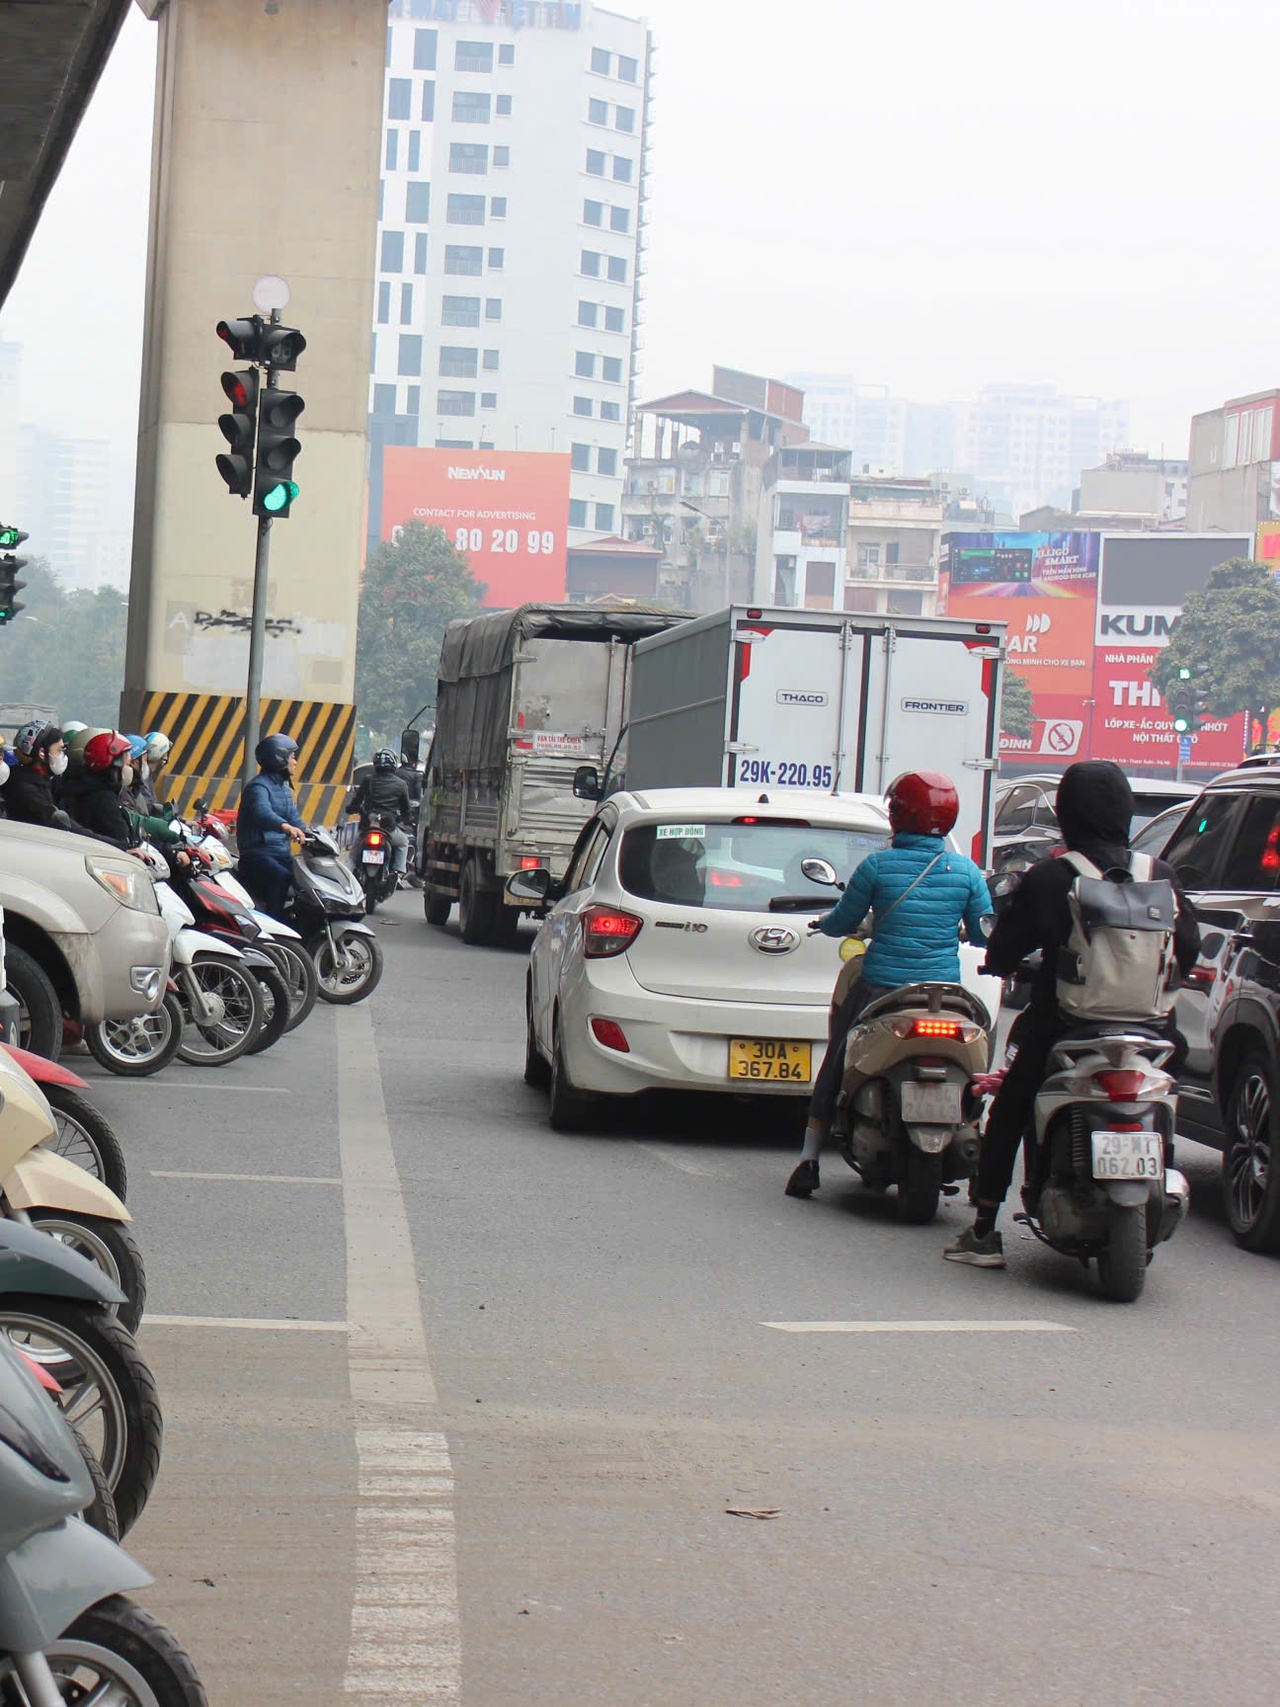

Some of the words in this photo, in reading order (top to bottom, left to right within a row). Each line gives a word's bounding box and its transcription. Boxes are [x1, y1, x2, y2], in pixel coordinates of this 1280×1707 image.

[413, 507, 455, 518] CONTACT
[457, 510, 475, 519] FOR
[477, 511, 536, 521] ADVERTISING
[455, 528, 483, 552] 80
[491, 529, 519, 553] 20
[527, 530, 554, 554] 99
[1100, 614, 1181, 636] KUM
[1005, 635, 1037, 653] AR
[1023, 658, 1041, 666] MINH
[1105, 653, 1125, 663] NHÀ
[782, 693, 824, 704] THACO
[905, 701, 965, 712] FRONTIER
[1154, 720, 1175, 731] QUY
[1133, 732, 1149, 744] NỘI
[1151, 732, 1174, 743] THẤT
[740, 759, 832, 788] 29K-220.95
[659, 828, 668, 837] XE
[753, 1042, 787, 1060] 30A
[738, 1060, 802, 1079] 367.84
[1097, 1157, 1157, 1176] 062.03
